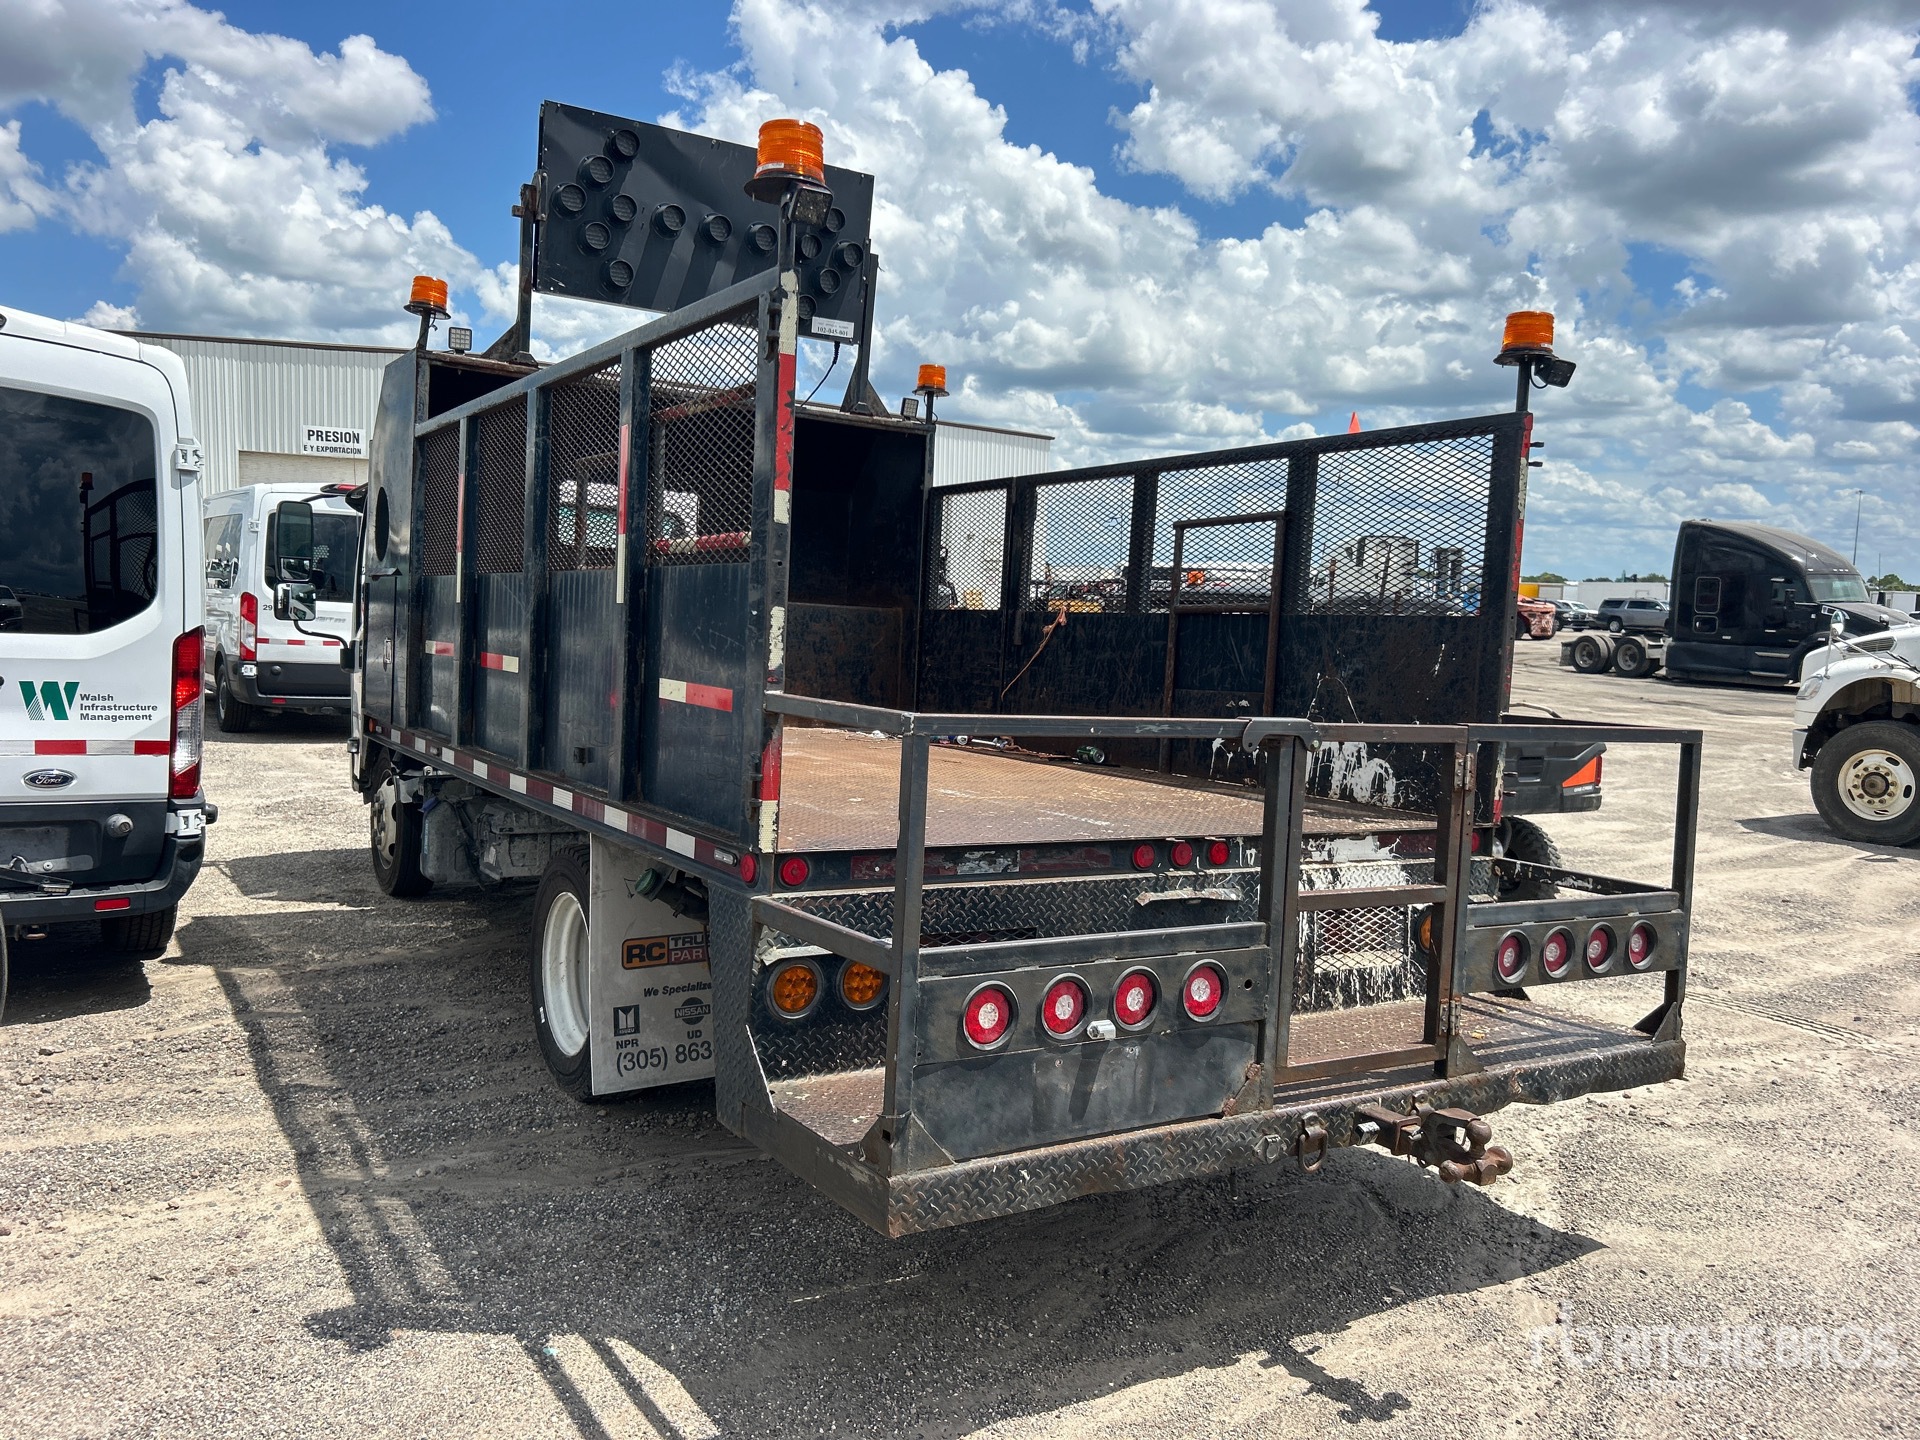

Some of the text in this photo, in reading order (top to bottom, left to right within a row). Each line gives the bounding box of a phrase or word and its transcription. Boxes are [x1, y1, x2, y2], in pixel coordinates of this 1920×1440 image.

[307, 429, 360, 444] PRESION
[303, 444, 308, 452] E
[316, 445, 361, 455] EXPORTACION
[79, 693, 114, 701] Walsh
[79, 703, 158, 711] Infrastructure
[79, 712, 153, 723] Management
[671, 934, 710, 948] TRU
[626, 942, 666, 964] RC
[643, 987, 659, 998] We
[675, 1006, 710, 1018] NISSAN
[687, 1029, 703, 1040] UD
[616, 1038, 639, 1050] NPR
[616, 1040, 713, 1078] (305) 863
